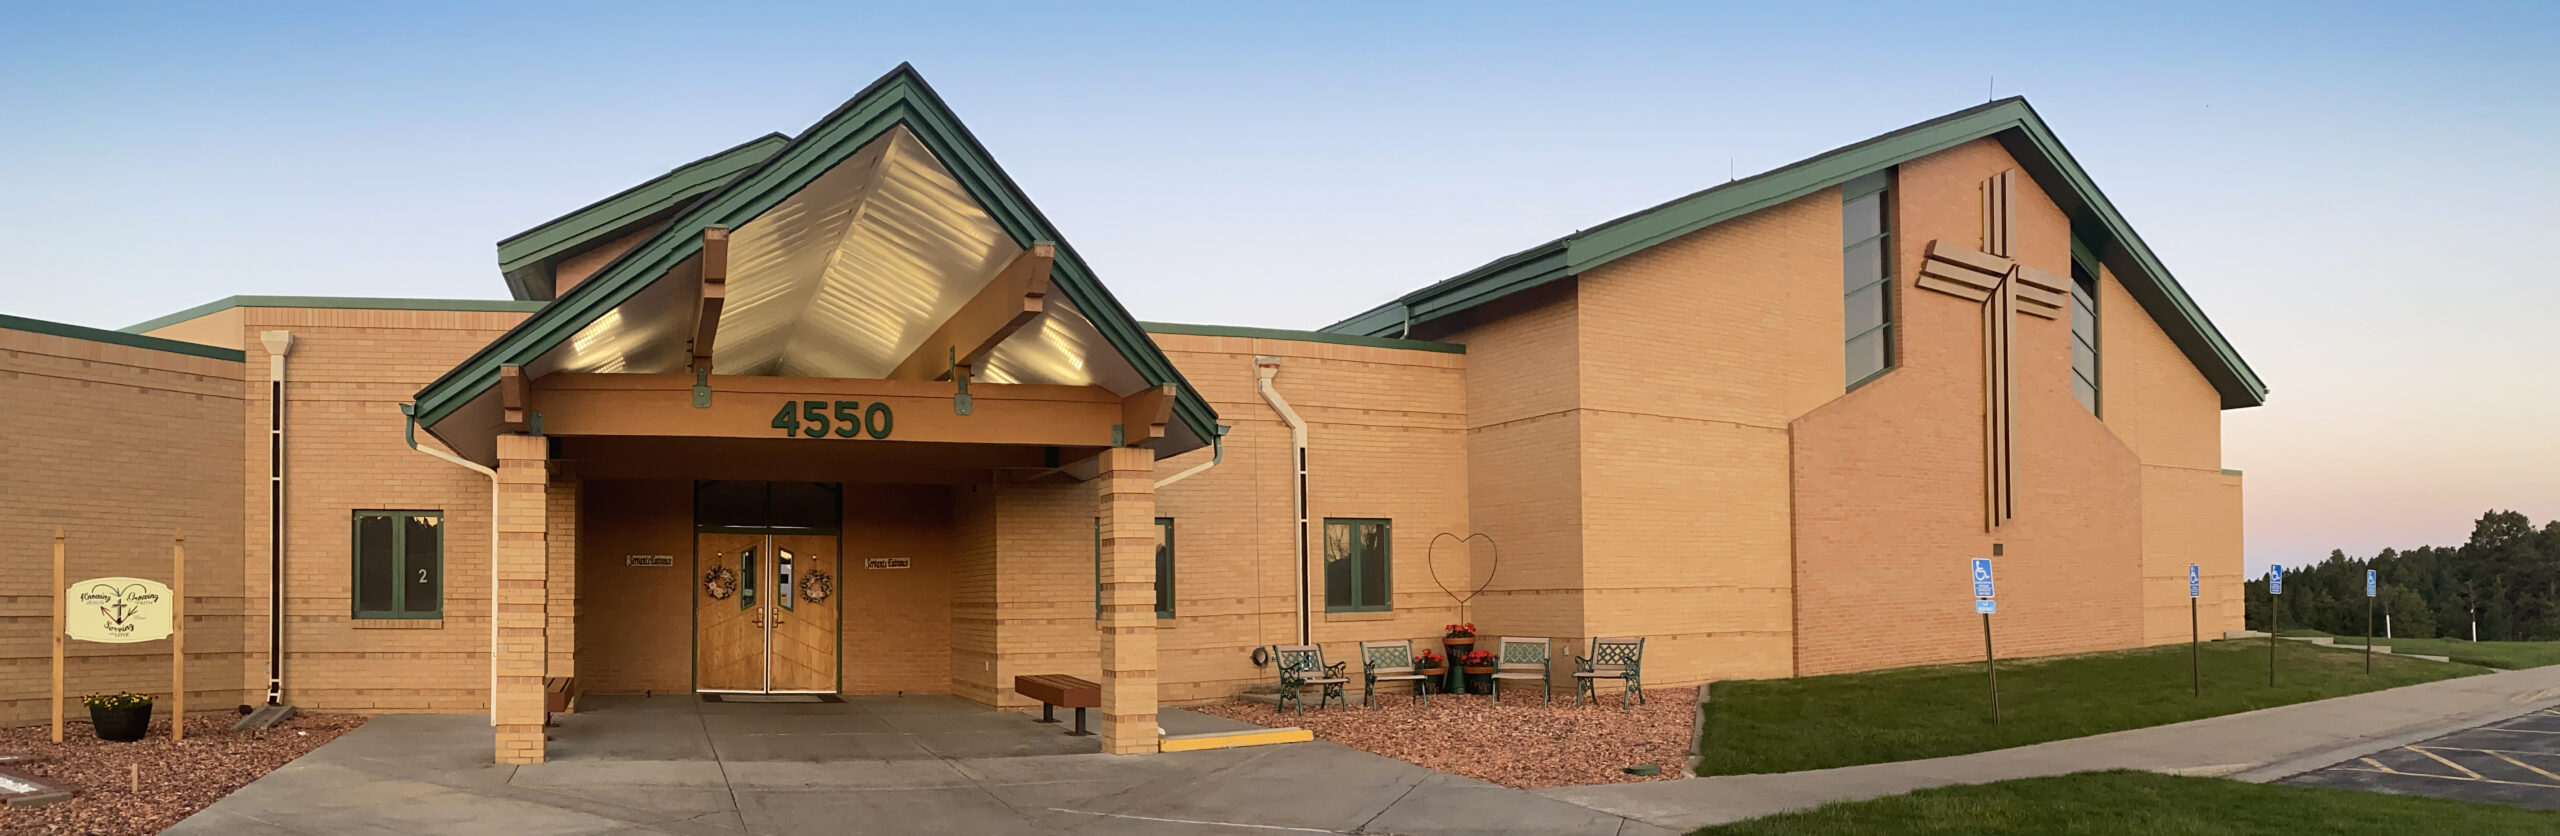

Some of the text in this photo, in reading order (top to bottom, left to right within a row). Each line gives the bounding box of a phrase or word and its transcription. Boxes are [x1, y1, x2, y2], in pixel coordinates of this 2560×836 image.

[771, 400, 893, 439] 4550
[418, 569, 428, 583] 2
[80, 592, 112, 603] Knowing
[126, 591, 159, 603] Growing
[104, 620, 135, 632] Serving
